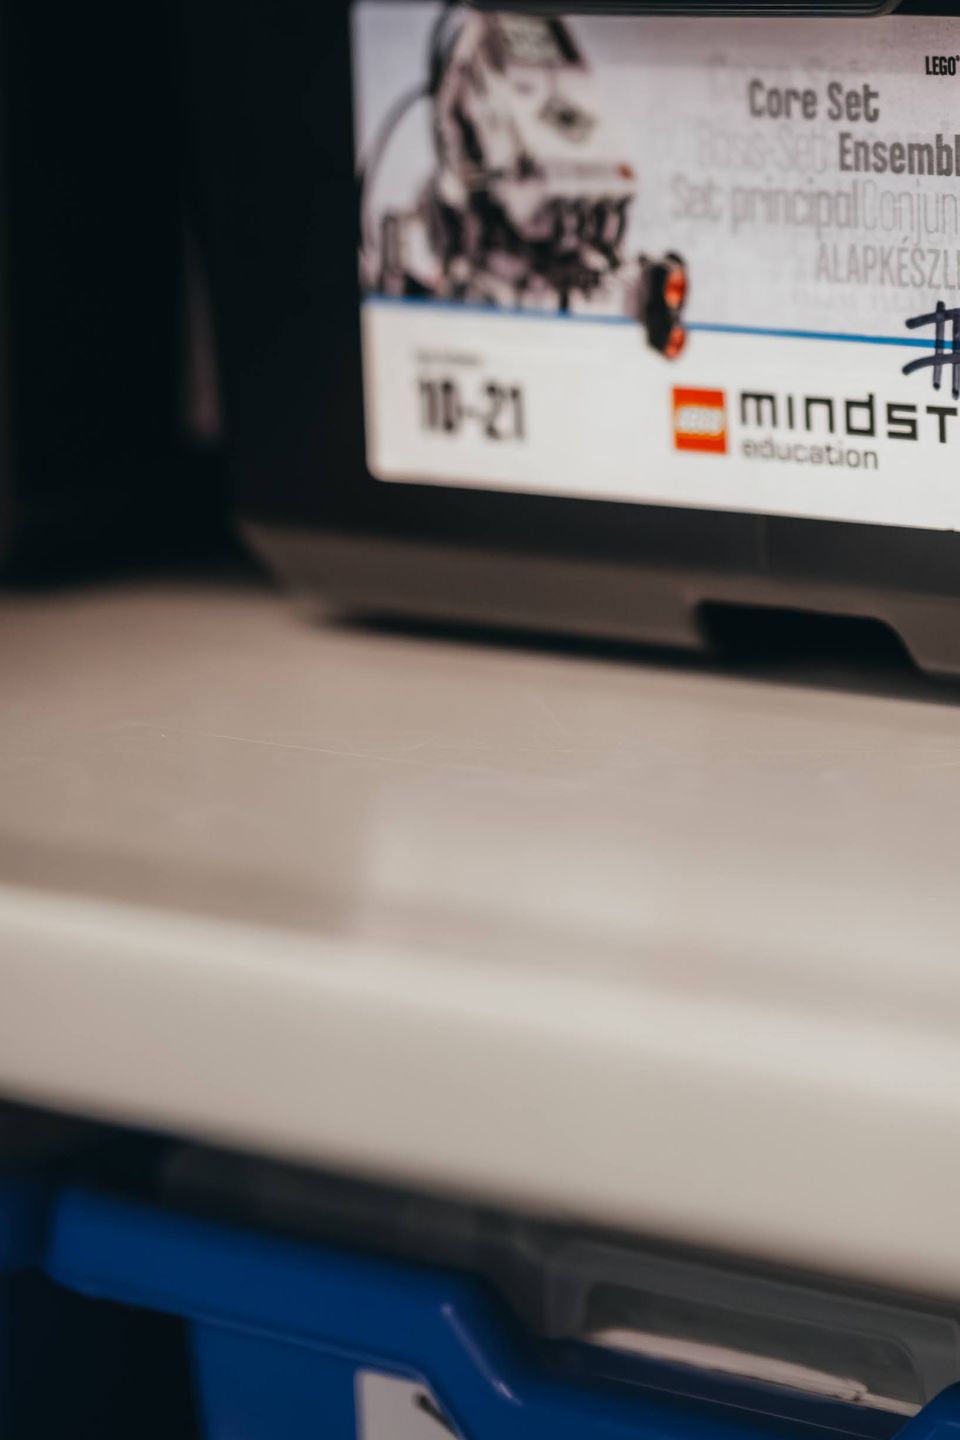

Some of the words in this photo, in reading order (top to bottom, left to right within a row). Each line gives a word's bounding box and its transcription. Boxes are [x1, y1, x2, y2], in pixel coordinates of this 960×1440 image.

[748, 78, 818, 120] Core
[827, 82, 881, 124] Set
[741, 437, 879, 470] education
